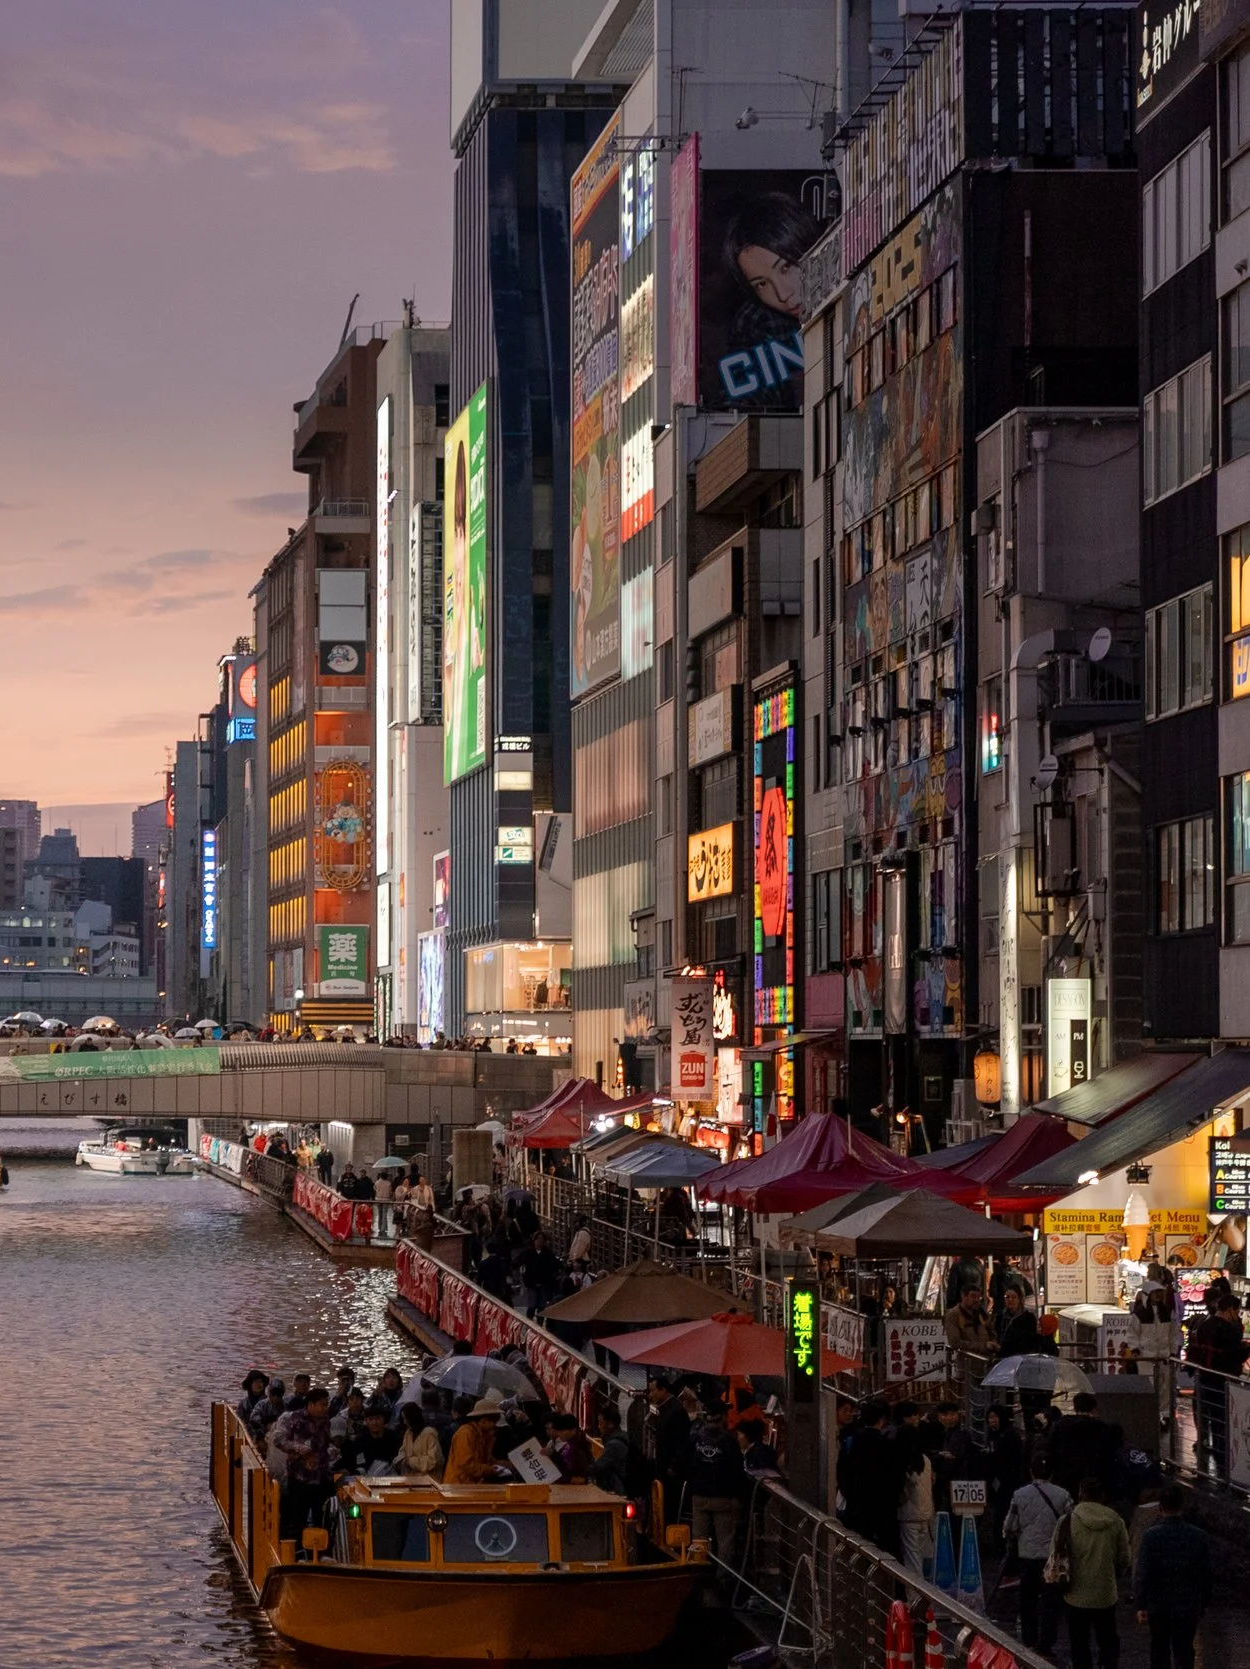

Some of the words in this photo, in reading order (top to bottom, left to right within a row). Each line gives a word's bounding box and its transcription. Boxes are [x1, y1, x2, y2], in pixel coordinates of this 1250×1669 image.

[328, 933, 357, 963] 薬
[1073, 1032, 1084, 1041] PM
[681, 1062, 705, 1074] ZUN
[40, 1092, 128, 1107] えびす橋
[1215, 1169, 1224, 1180] A
[1216, 1184, 1224, 1194] B
[1216, 1199, 1225, 1210] C
[1050, 1212, 1095, 1223] Stamina
[1167, 1212, 1200, 1223] Menu
[793, 1292, 813, 1376] 着場です。
[902, 1325, 938, 1336] KOBE
